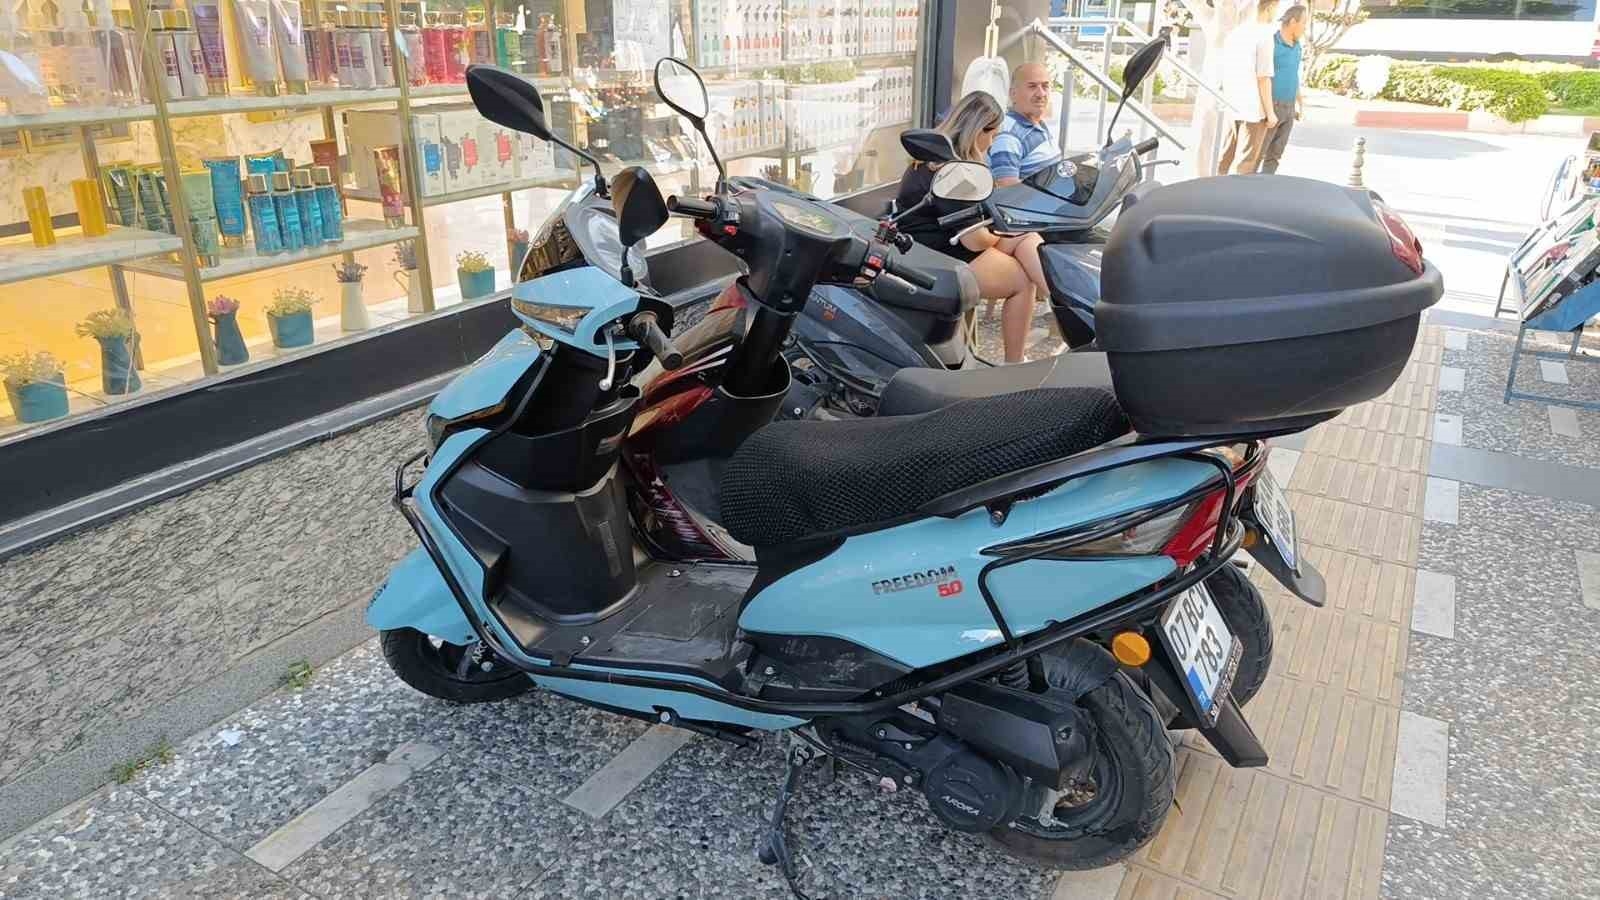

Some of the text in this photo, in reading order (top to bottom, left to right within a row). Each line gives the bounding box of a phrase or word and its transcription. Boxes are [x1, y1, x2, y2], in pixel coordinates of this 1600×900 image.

[872, 564, 957, 596] FREEDOM
[937, 579, 964, 598] 50
[1194, 625, 1223, 686] 783
[940, 795, 980, 817] ARORA
